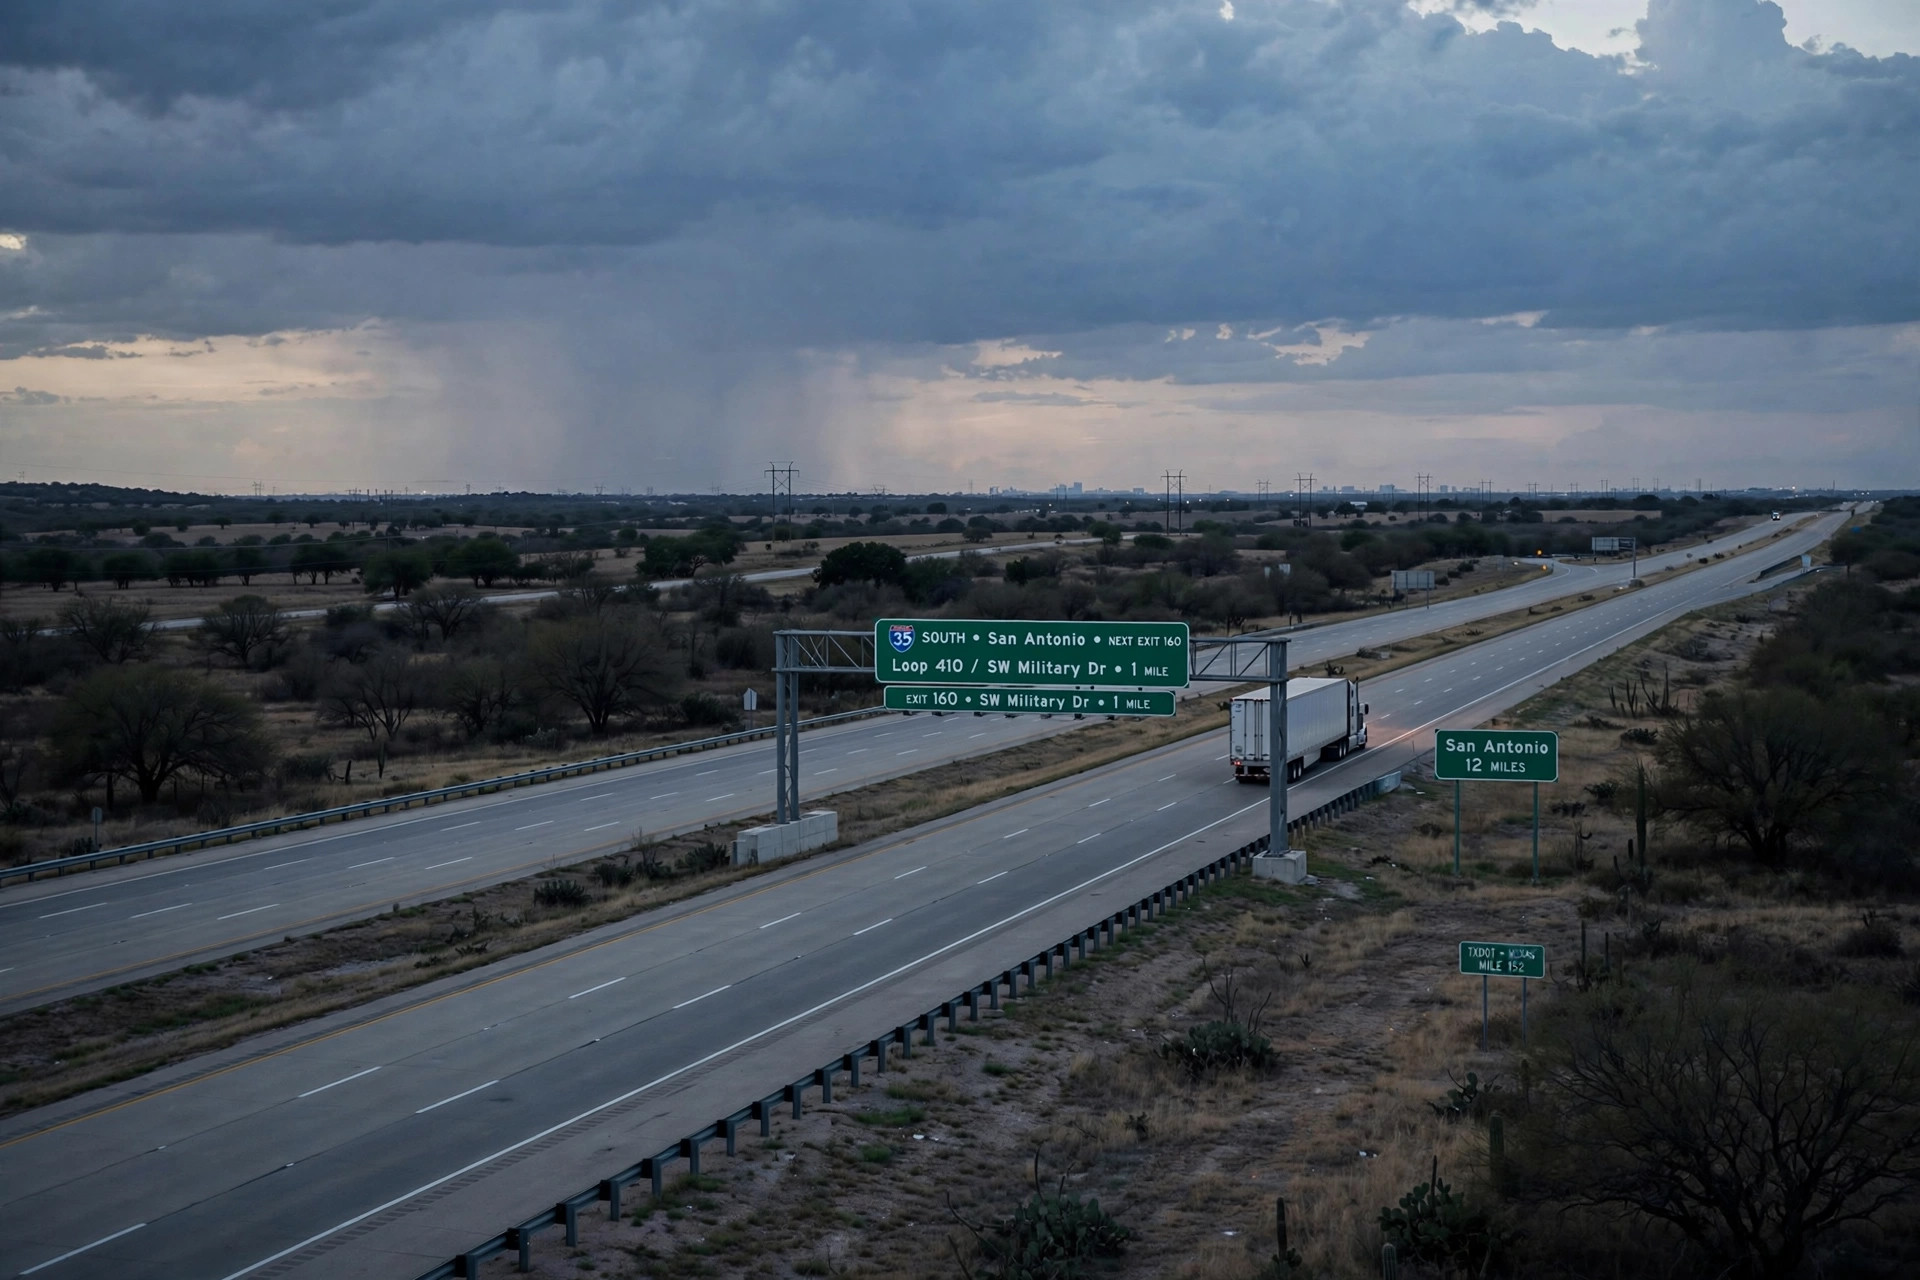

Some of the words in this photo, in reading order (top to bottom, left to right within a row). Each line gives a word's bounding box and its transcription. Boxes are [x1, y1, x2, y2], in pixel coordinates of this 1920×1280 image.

[893, 632, 913, 646] 35
[921, 631, 966, 644] SOUTH
[988, 632, 1017, 645] San
[1024, 632, 1086, 646] Antonio
[1108, 636, 1133, 646] NEXT
[1137, 636, 1160, 646] EXIT
[1164, 636, 1181, 647] 160
[892, 658, 928, 675] Loop
[935, 658, 964, 673] 410
[971, 658, 979, 674] /
[987, 660, 1010, 674] SW
[1018, 661, 1081, 678] Military
[1088, 662, 1106, 676] Dr
[1131, 662, 1137, 676] 1
[1144, 666, 1169, 677] MILE
[906, 694, 928, 704] EXIT
[933, 692, 958, 706] 160
[979, 693, 1000, 706] SW
[1007, 694, 1065, 710] Military
[1073, 695, 1089, 708] Dr
[1113, 695, 1118, 709] 1
[1126, 699, 1150, 709] MILE
[1446, 738, 1475, 752] San
[1483, 739, 1549, 754] Antonio
[1465, 758, 1482, 772] 12
[1490, 761, 1526, 773] MILES
[1468, 946, 1495, 958] TXDOT
[1479, 960, 1503, 972] MILE
[1508, 961, 1525, 973] 152
